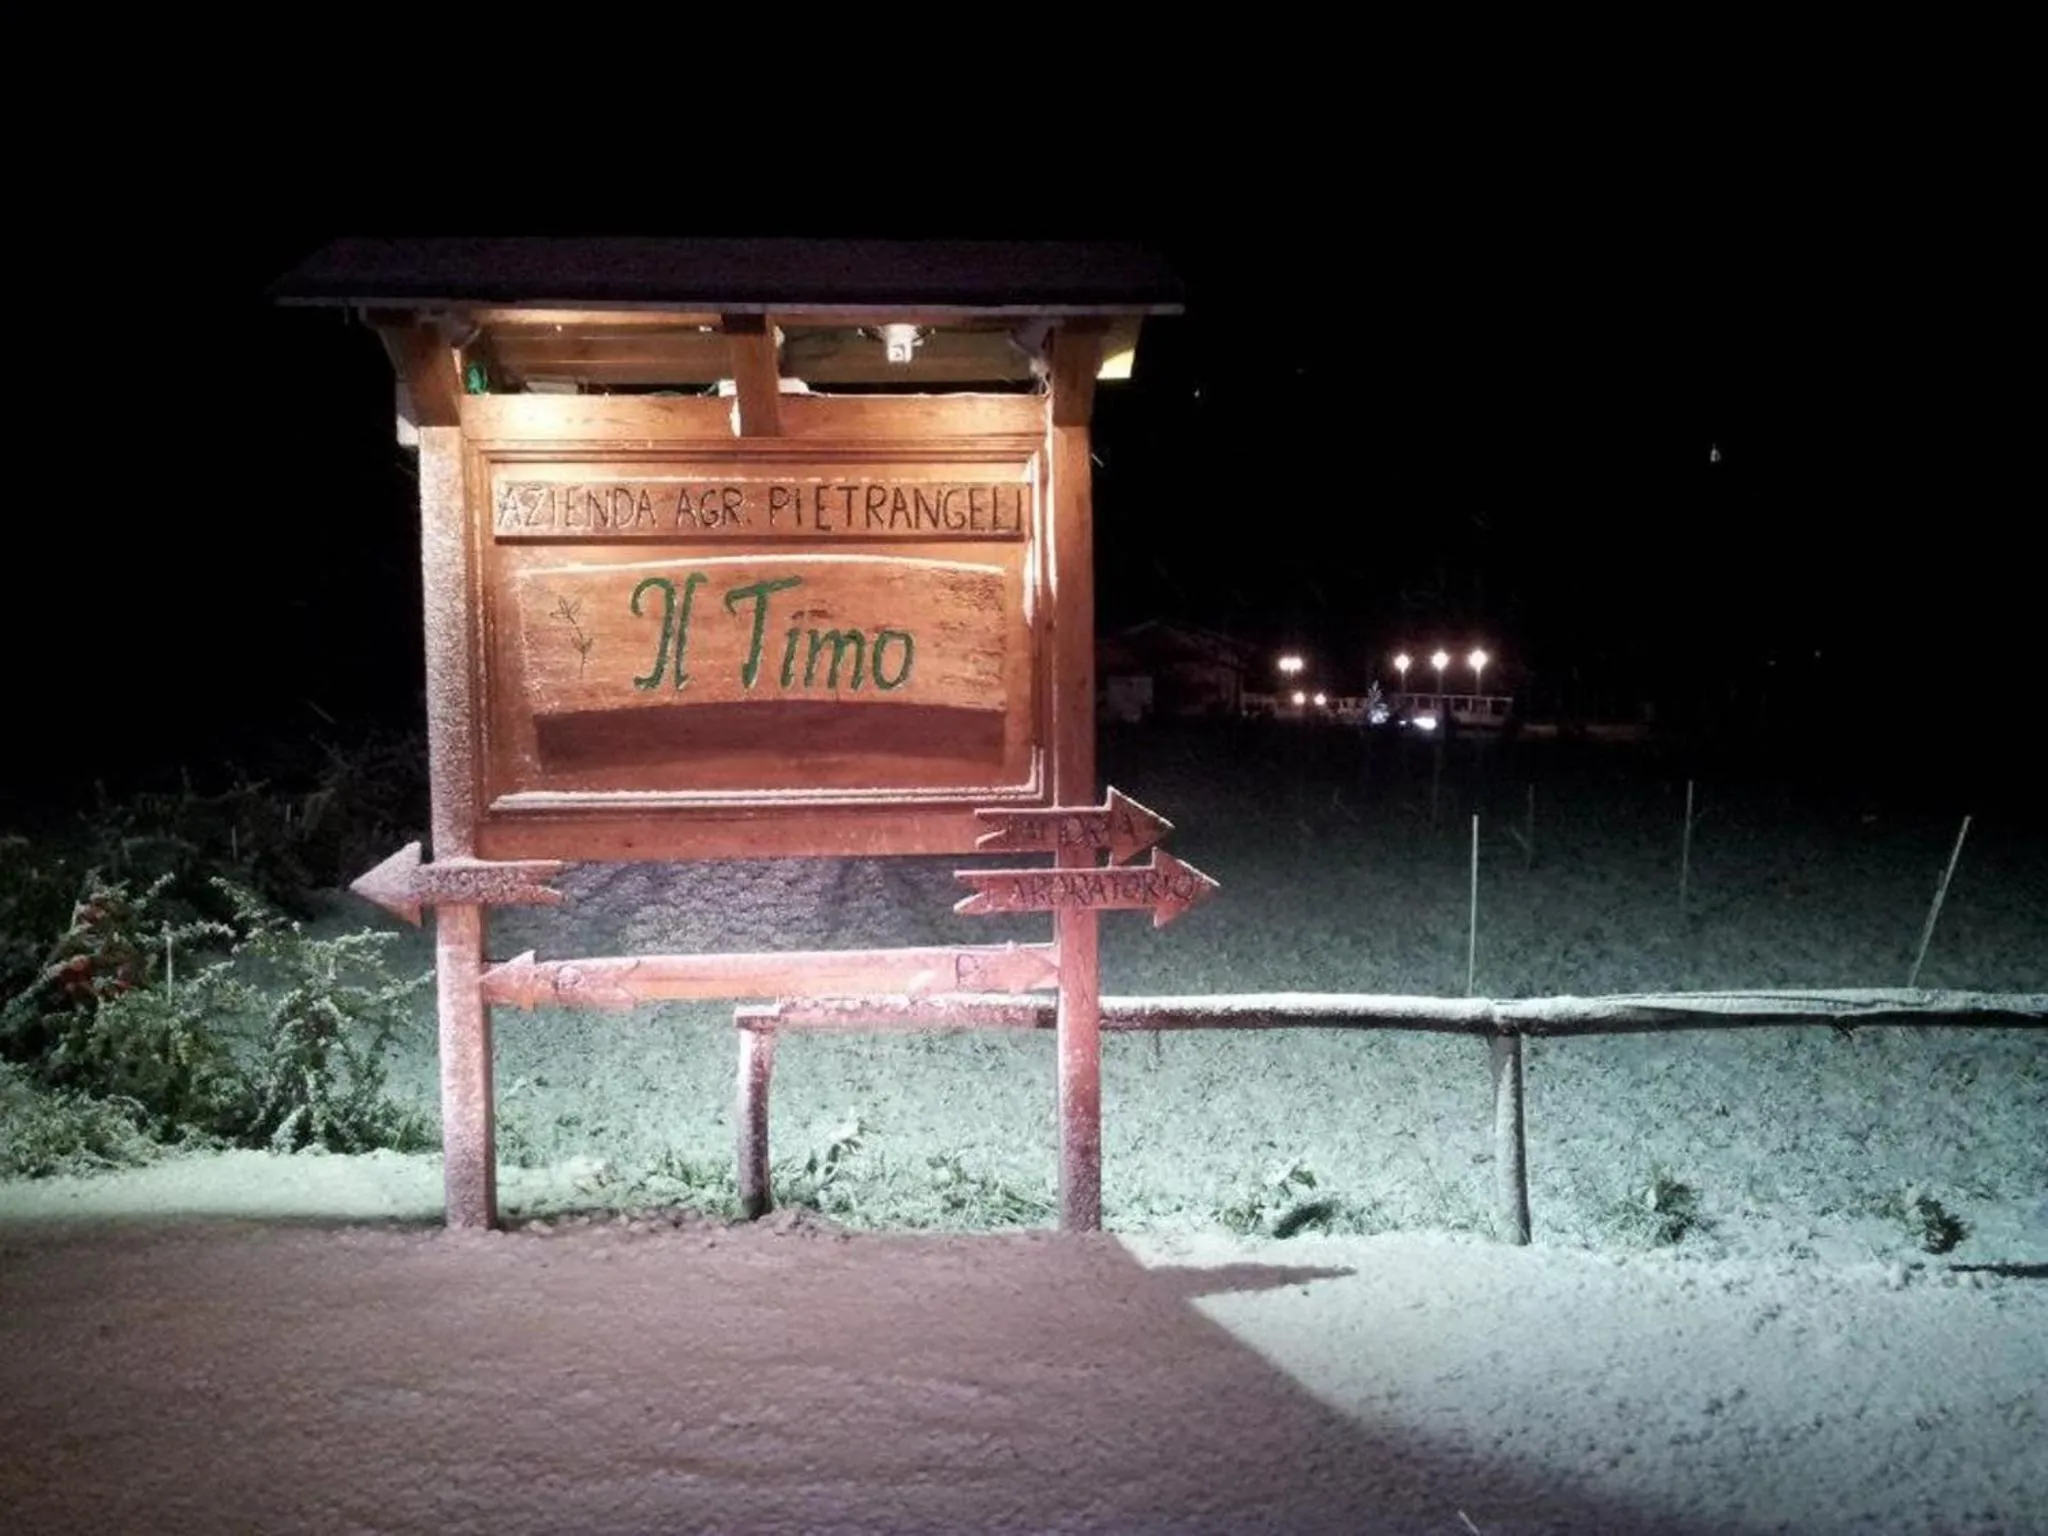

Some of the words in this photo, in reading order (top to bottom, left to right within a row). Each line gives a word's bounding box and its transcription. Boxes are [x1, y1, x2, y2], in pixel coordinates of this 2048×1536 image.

[497, 484, 657, 529] AZIENDA
[768, 483, 1022, 531] PIETRANGELI
[724, 575, 914, 691] Timo
